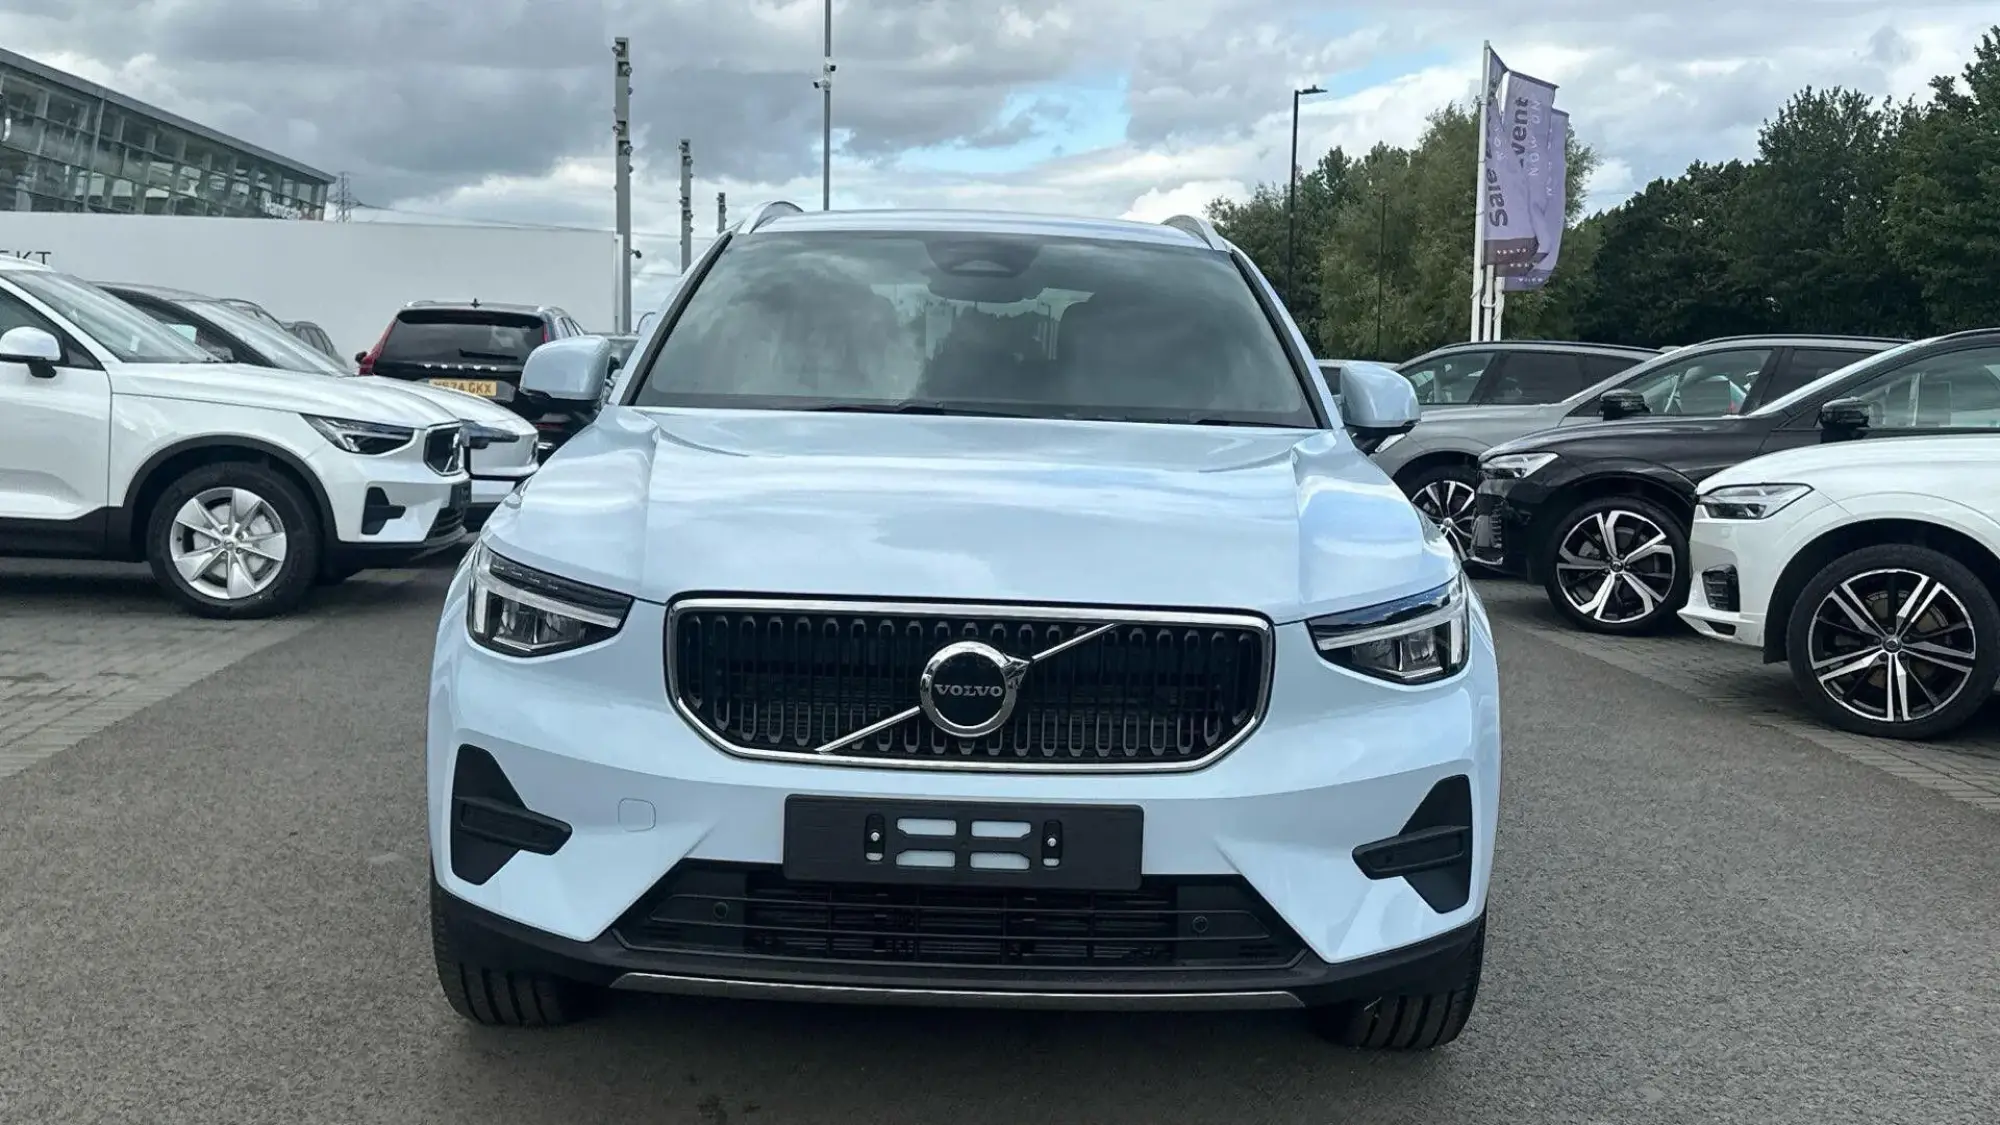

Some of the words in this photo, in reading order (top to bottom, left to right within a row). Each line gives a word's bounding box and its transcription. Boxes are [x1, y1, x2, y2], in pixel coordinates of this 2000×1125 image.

[1511, 97, 1529, 168] vent
[468, 382, 492, 395] GKX
[934, 684, 1003, 697] VOLVO
